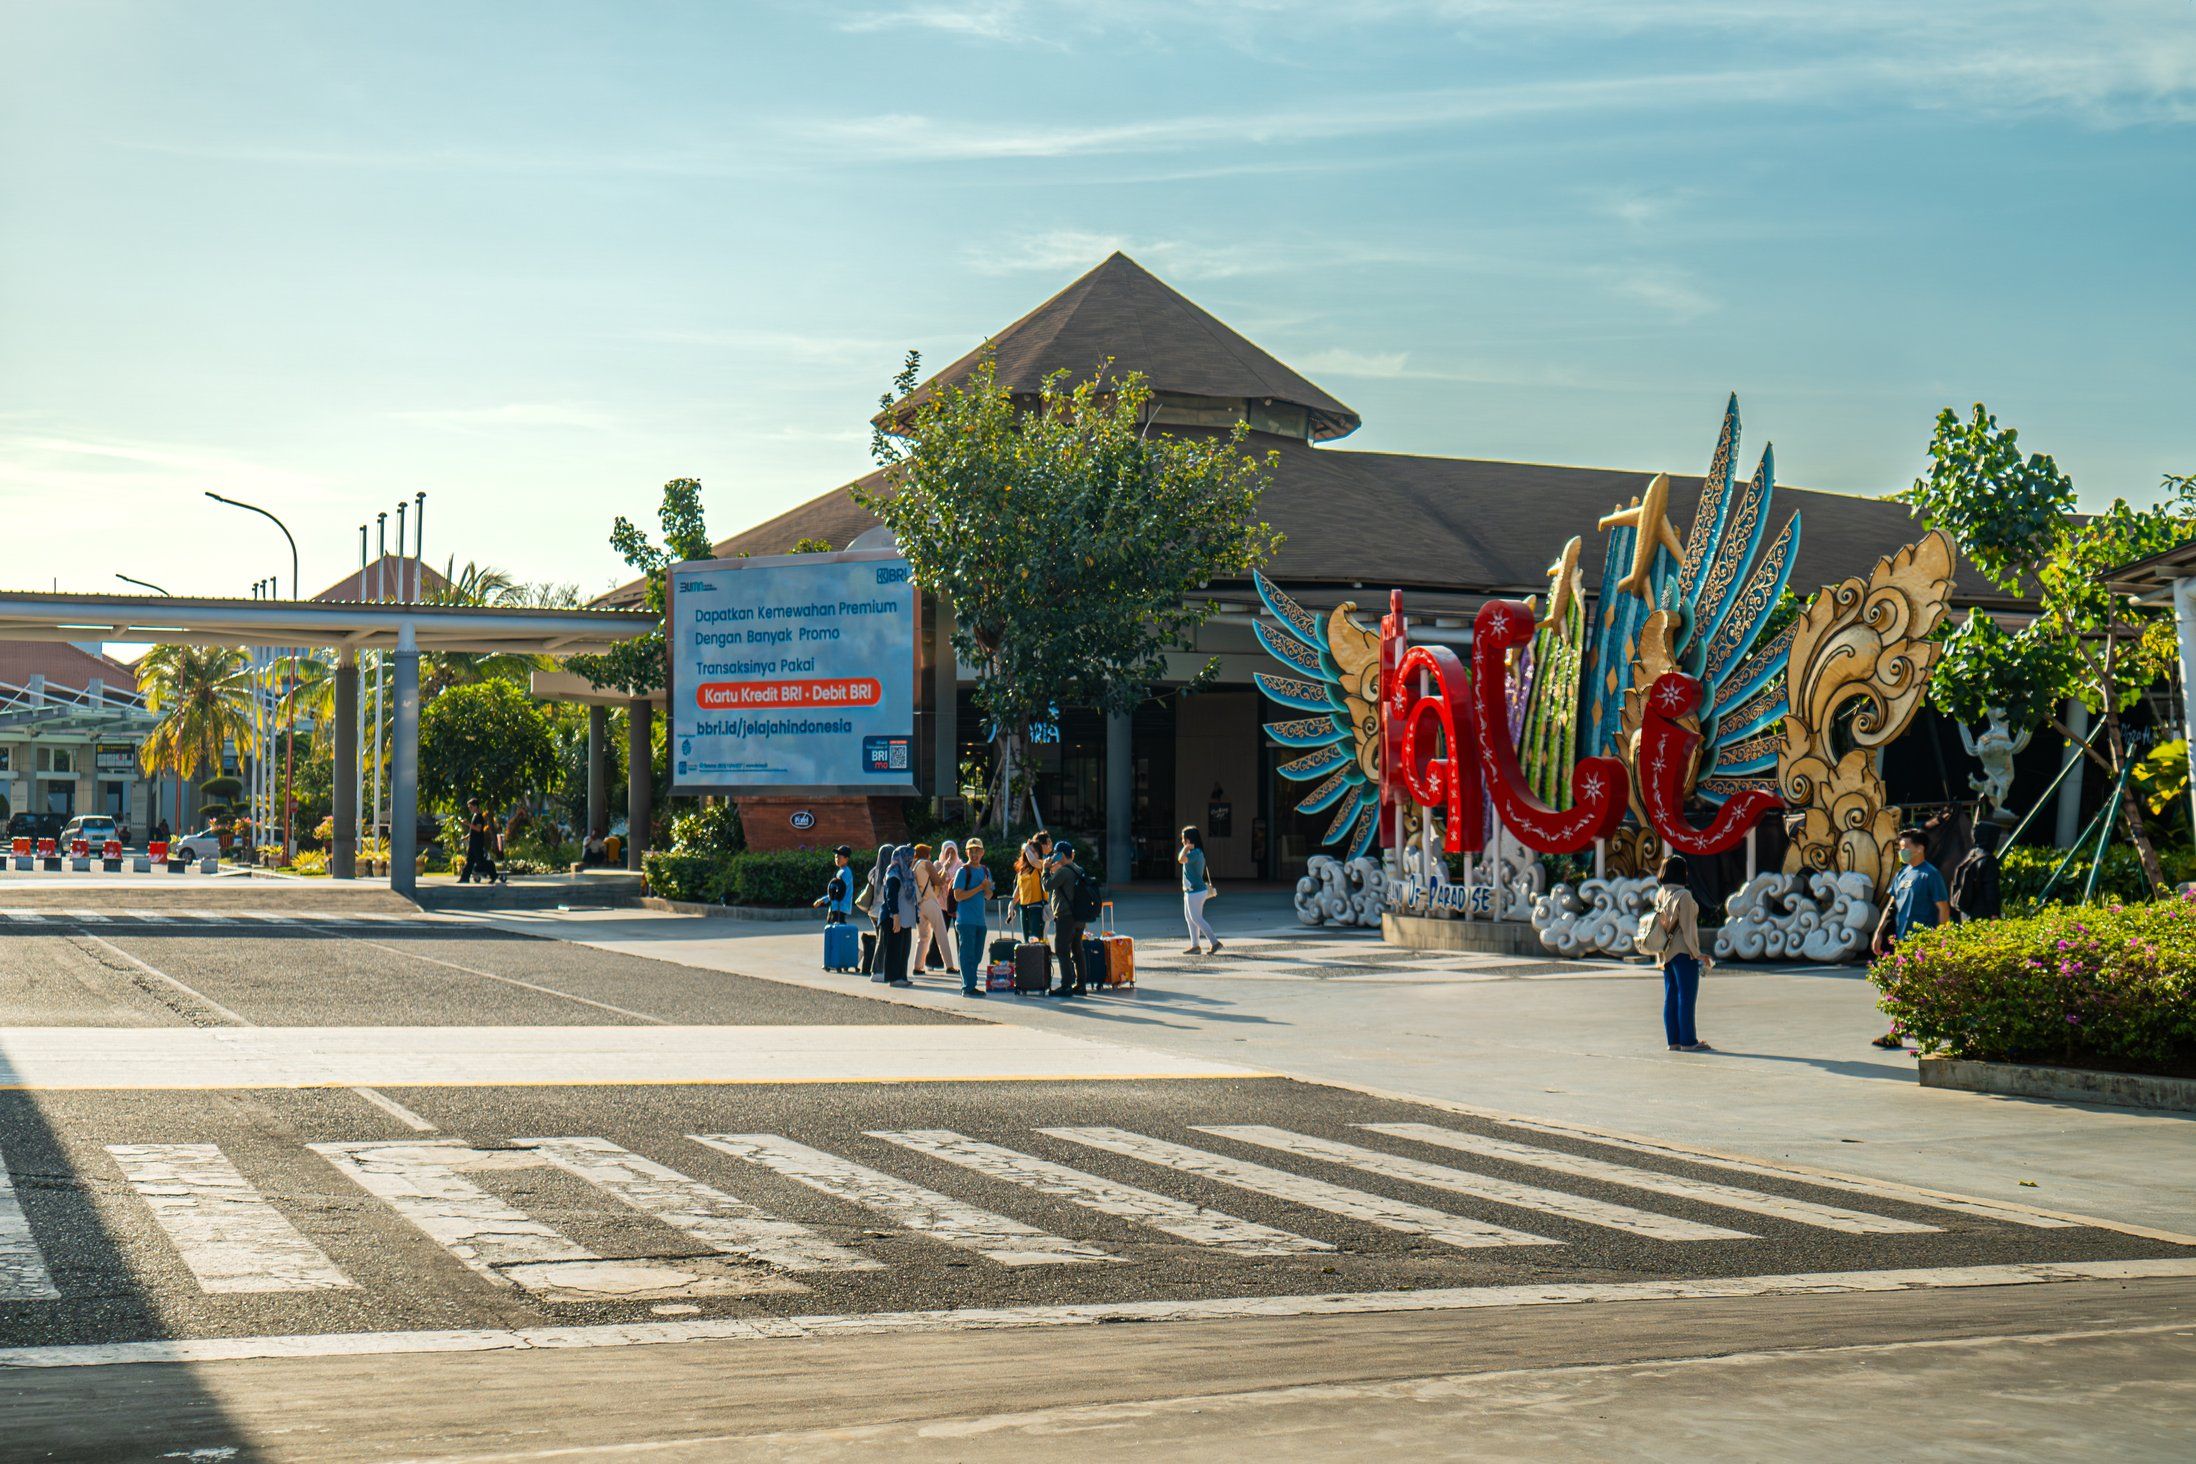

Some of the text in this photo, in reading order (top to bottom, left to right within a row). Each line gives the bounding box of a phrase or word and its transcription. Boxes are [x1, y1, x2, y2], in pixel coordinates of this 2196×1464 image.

[695, 599, 898, 625] Dapatkan Kemewahan Premium
[695, 627, 841, 648] Dengan Banyak Promo
[696, 657, 815, 677] Transaksinya Pakai
[704, 684, 872, 704] Kartu Kredit BRI Debit BRI
[696, 717, 852, 739] bbri.id/jelajahindonesia
[871, 750, 888, 762] BRI
